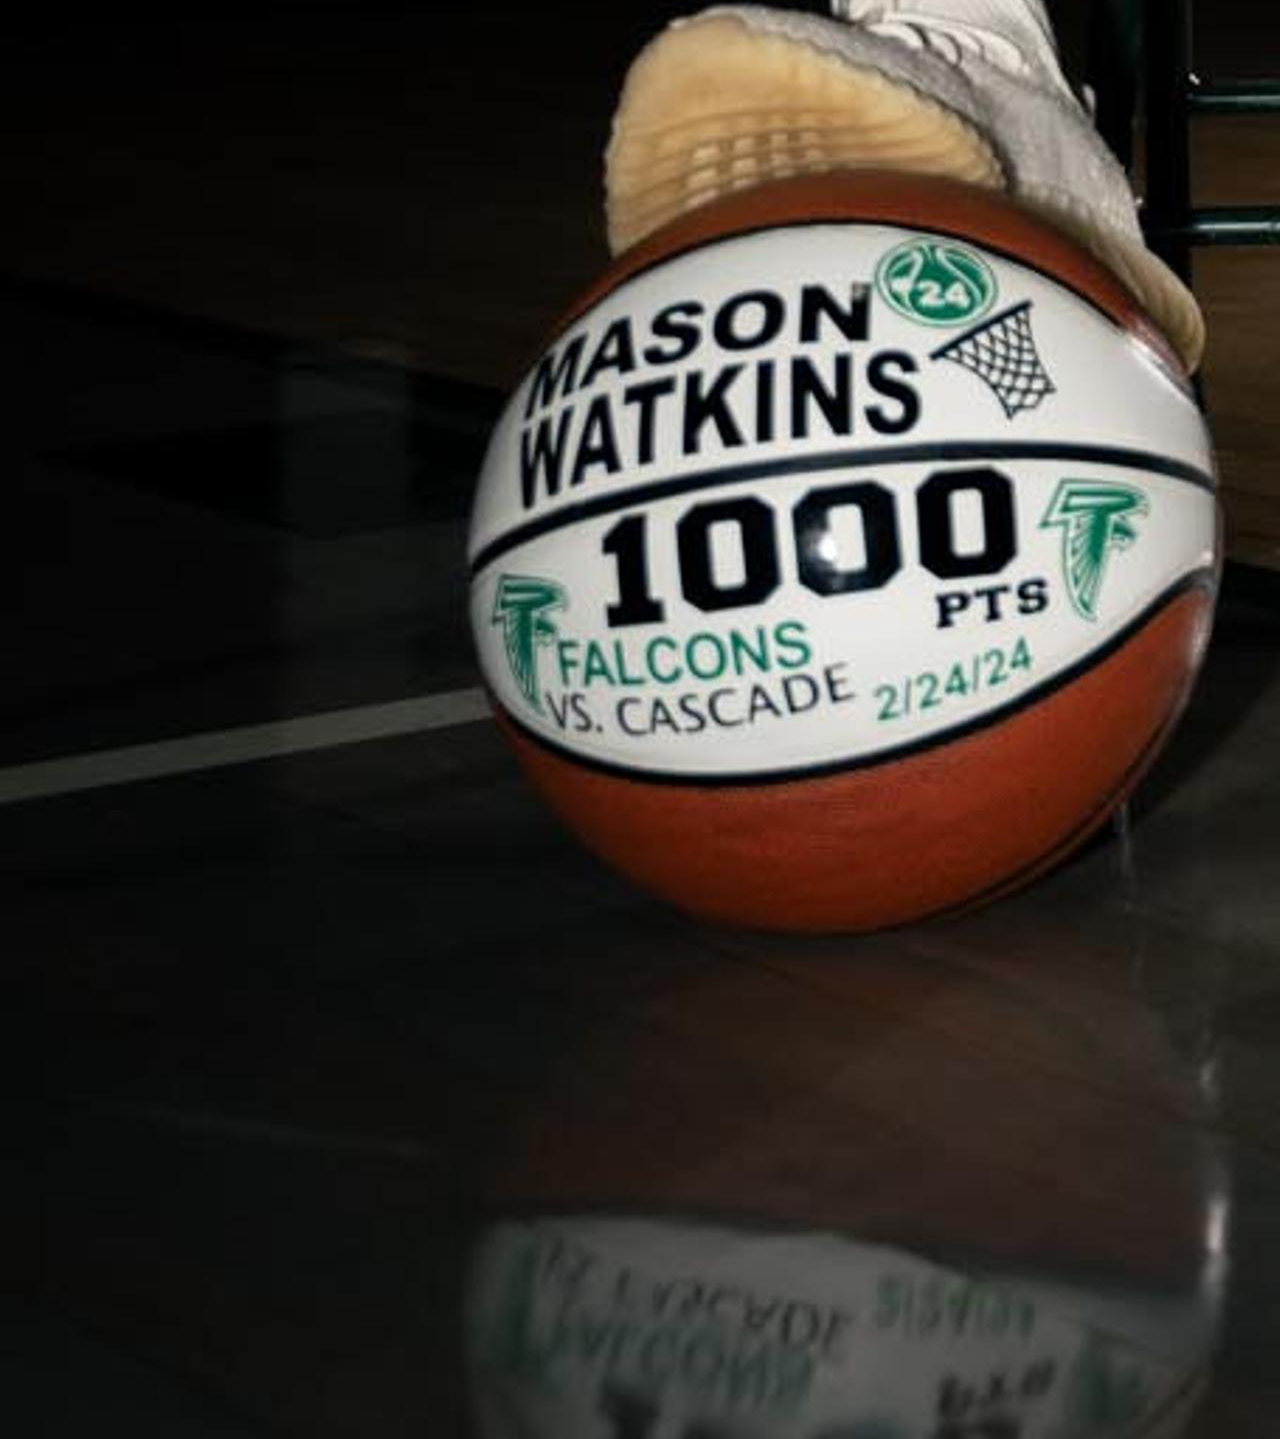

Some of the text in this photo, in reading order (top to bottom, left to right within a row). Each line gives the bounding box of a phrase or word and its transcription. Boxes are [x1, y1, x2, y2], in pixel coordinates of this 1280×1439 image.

[524, 282, 873, 422] MASON
[519, 352, 920, 509] WATKINS
[603, 468, 1016, 629] 1000
[935, 580, 1049, 629] PTS
[556, 620, 813, 688] FALCONS
[875, 637, 1033, 722] 2/24/24
[544, 664, 857, 737] VS. CASCADE
